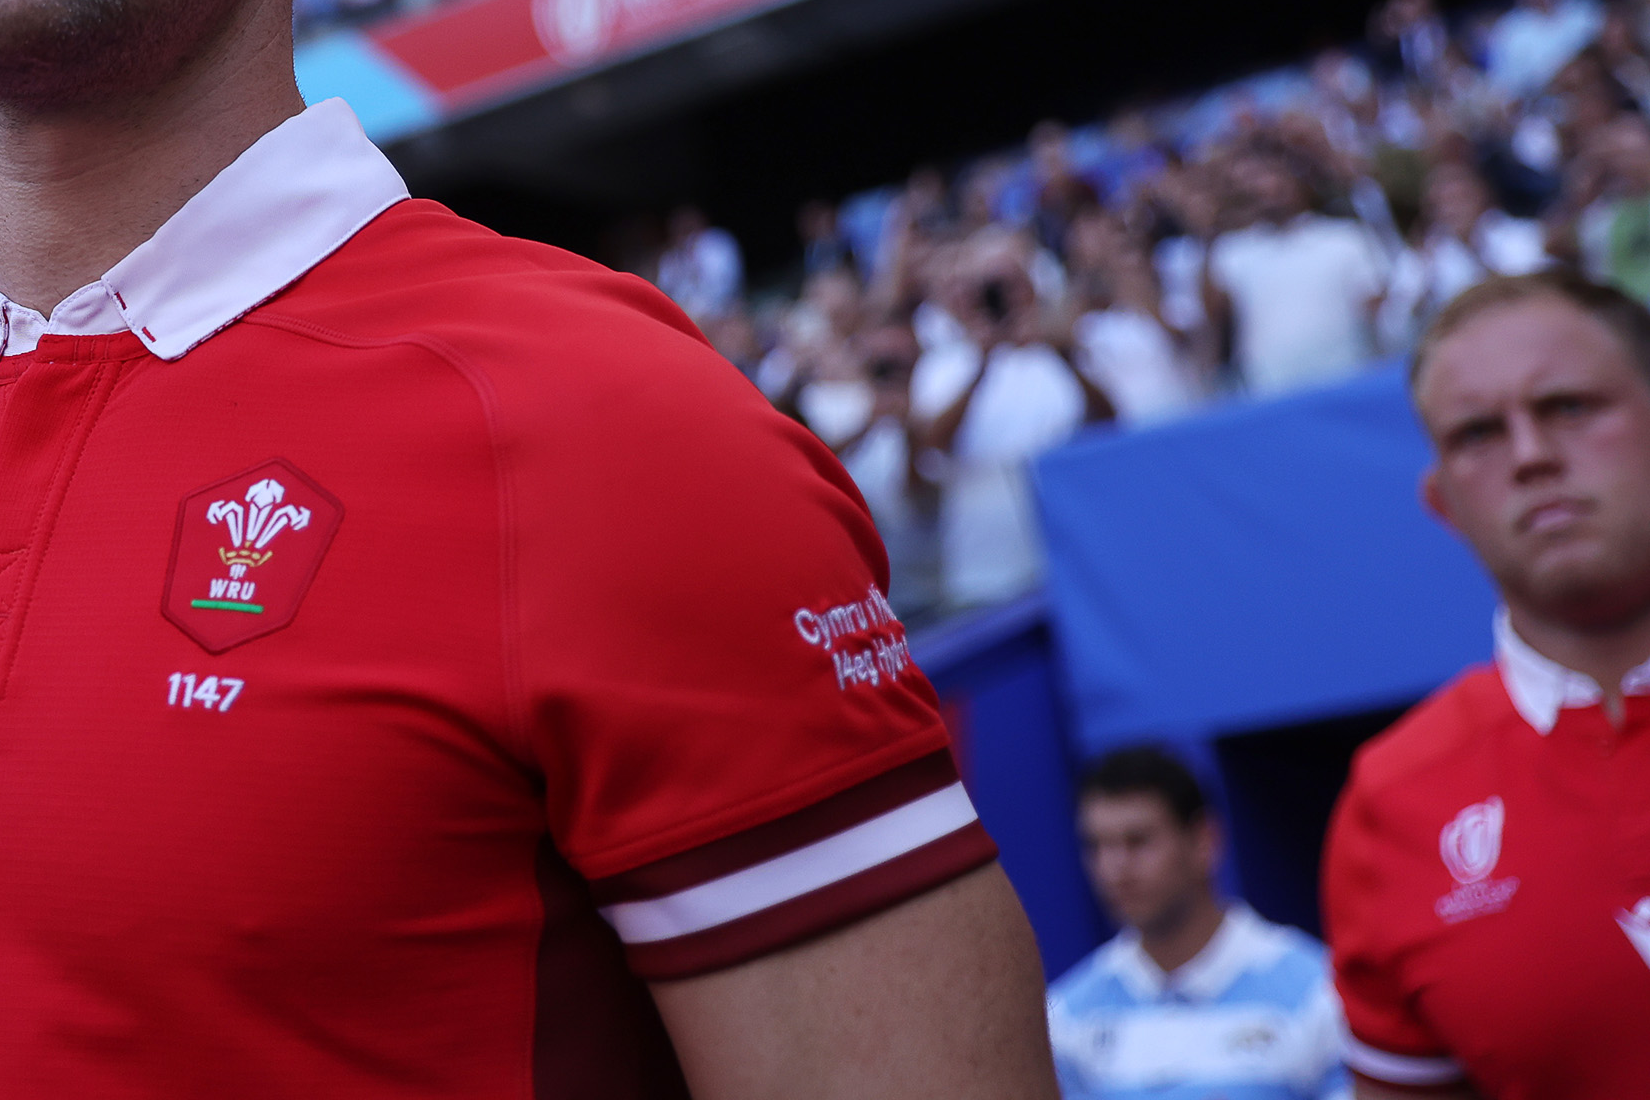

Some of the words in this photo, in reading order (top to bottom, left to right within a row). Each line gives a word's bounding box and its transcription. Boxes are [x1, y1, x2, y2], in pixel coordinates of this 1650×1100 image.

[208, 578, 255, 600] WRU
[793, 601, 868, 651] Cymru
[167, 671, 245, 713] 1147
